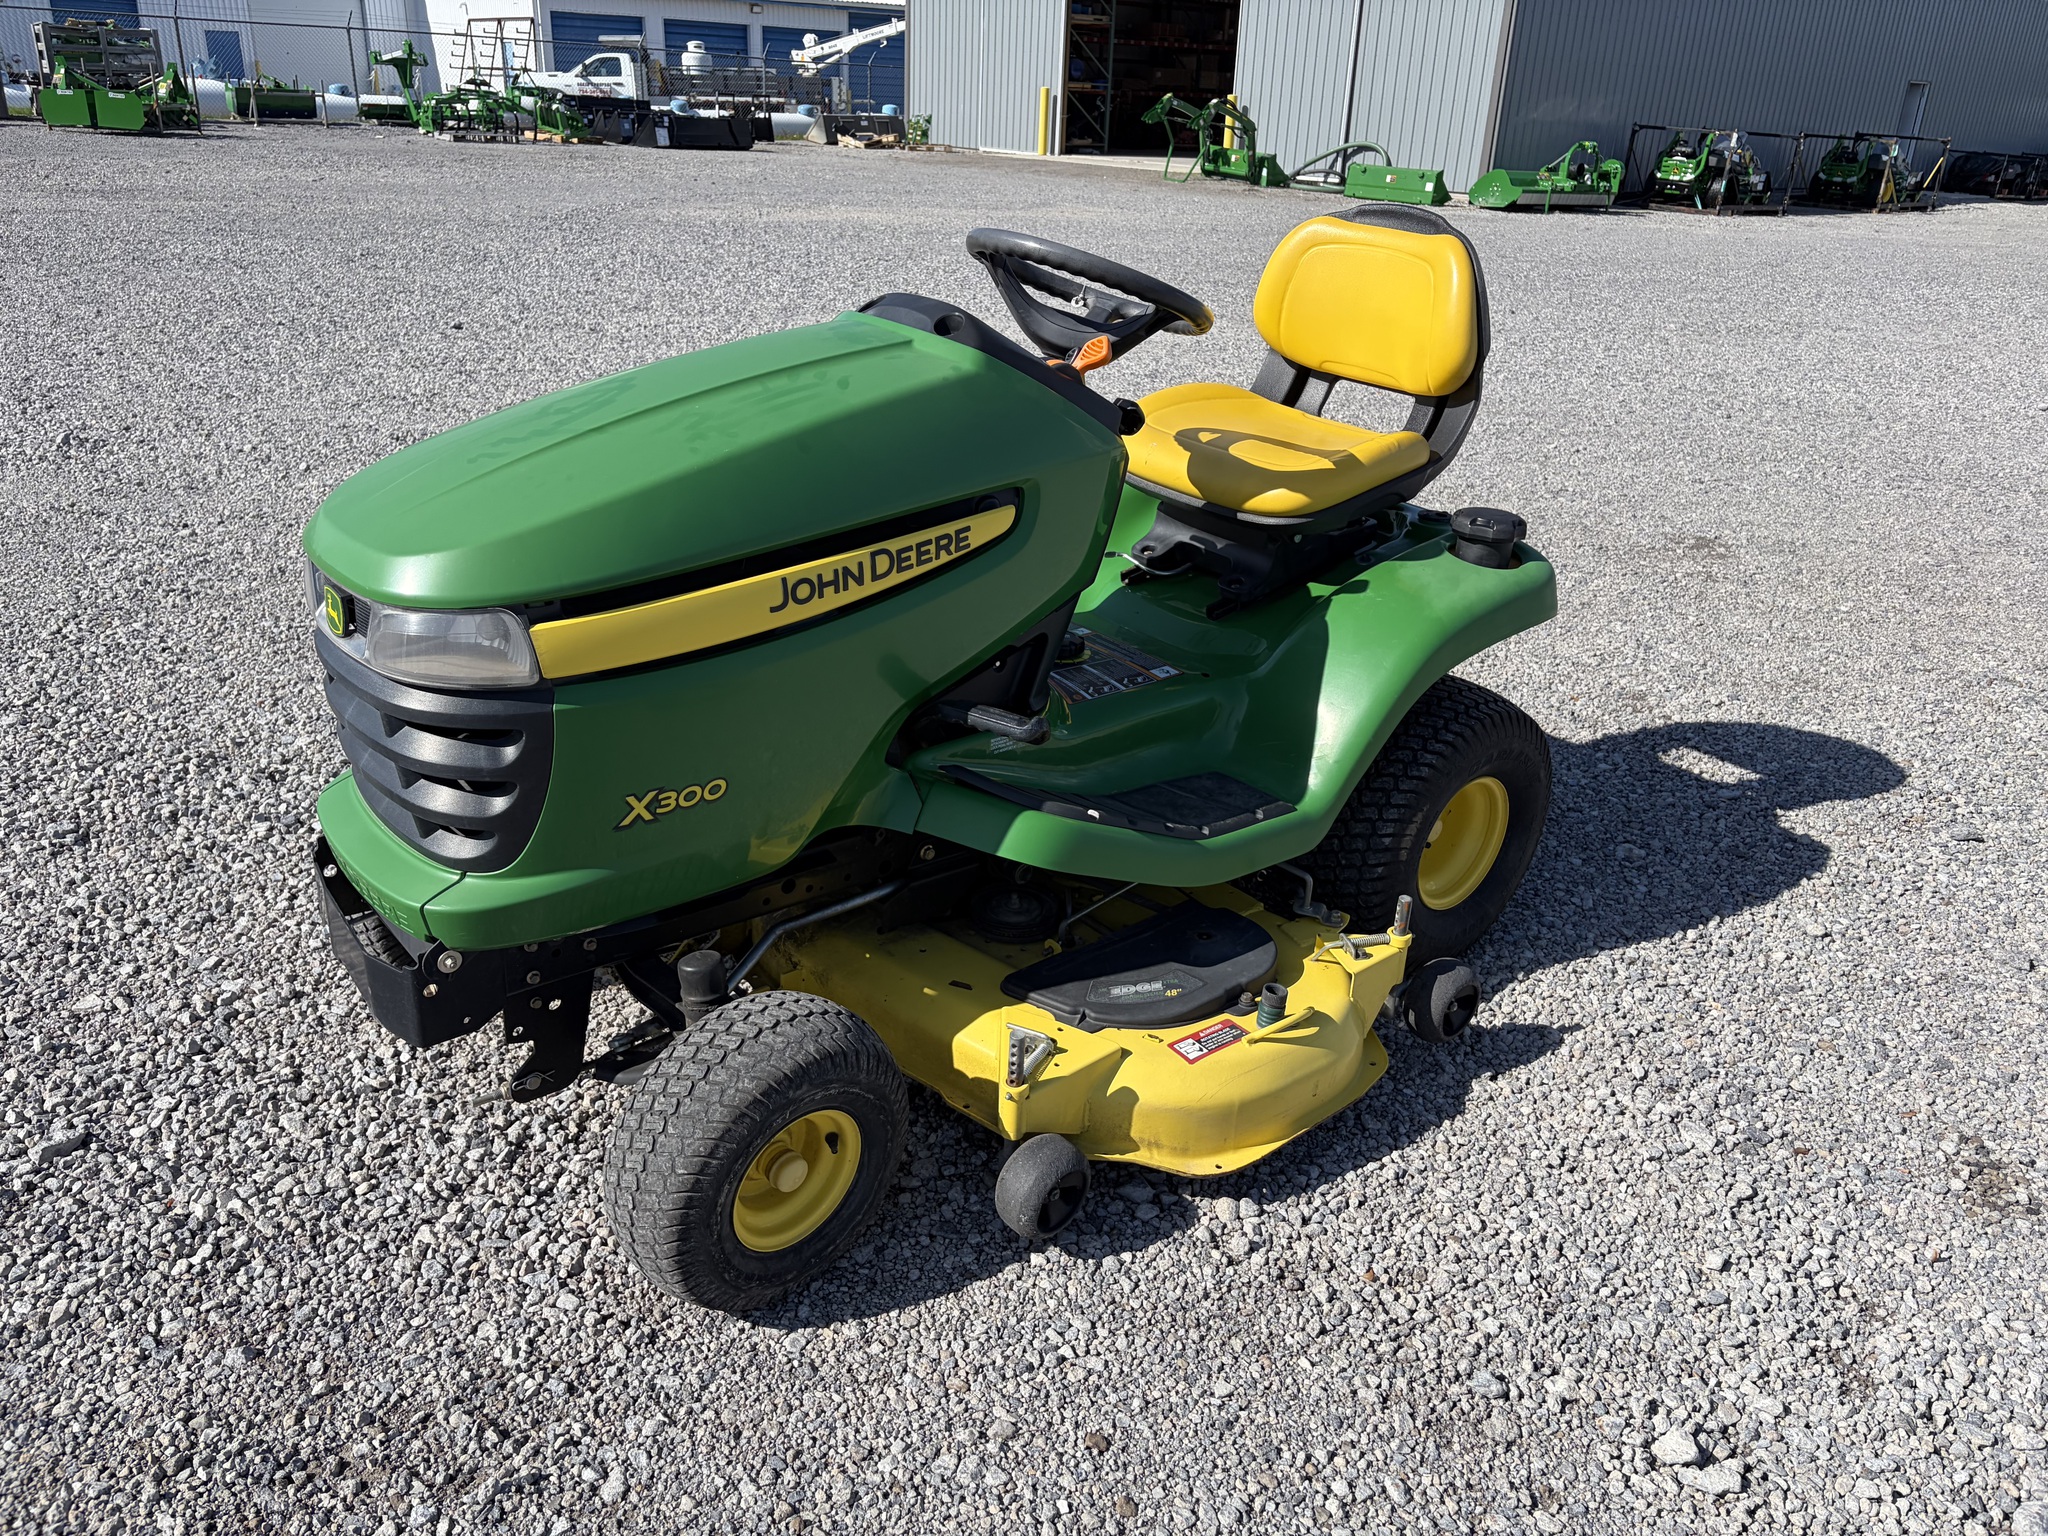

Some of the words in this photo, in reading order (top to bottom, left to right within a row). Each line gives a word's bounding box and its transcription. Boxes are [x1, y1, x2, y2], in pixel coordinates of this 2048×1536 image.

[769, 561, 865, 614] JOHN
[869, 525, 972, 583] DEERE
[614, 778, 728, 832] X300
[1109, 980, 1163, 998] EDGE
[1164, 988, 1182, 997] 48"
[1203, 1024, 1224, 1034] DANGER
